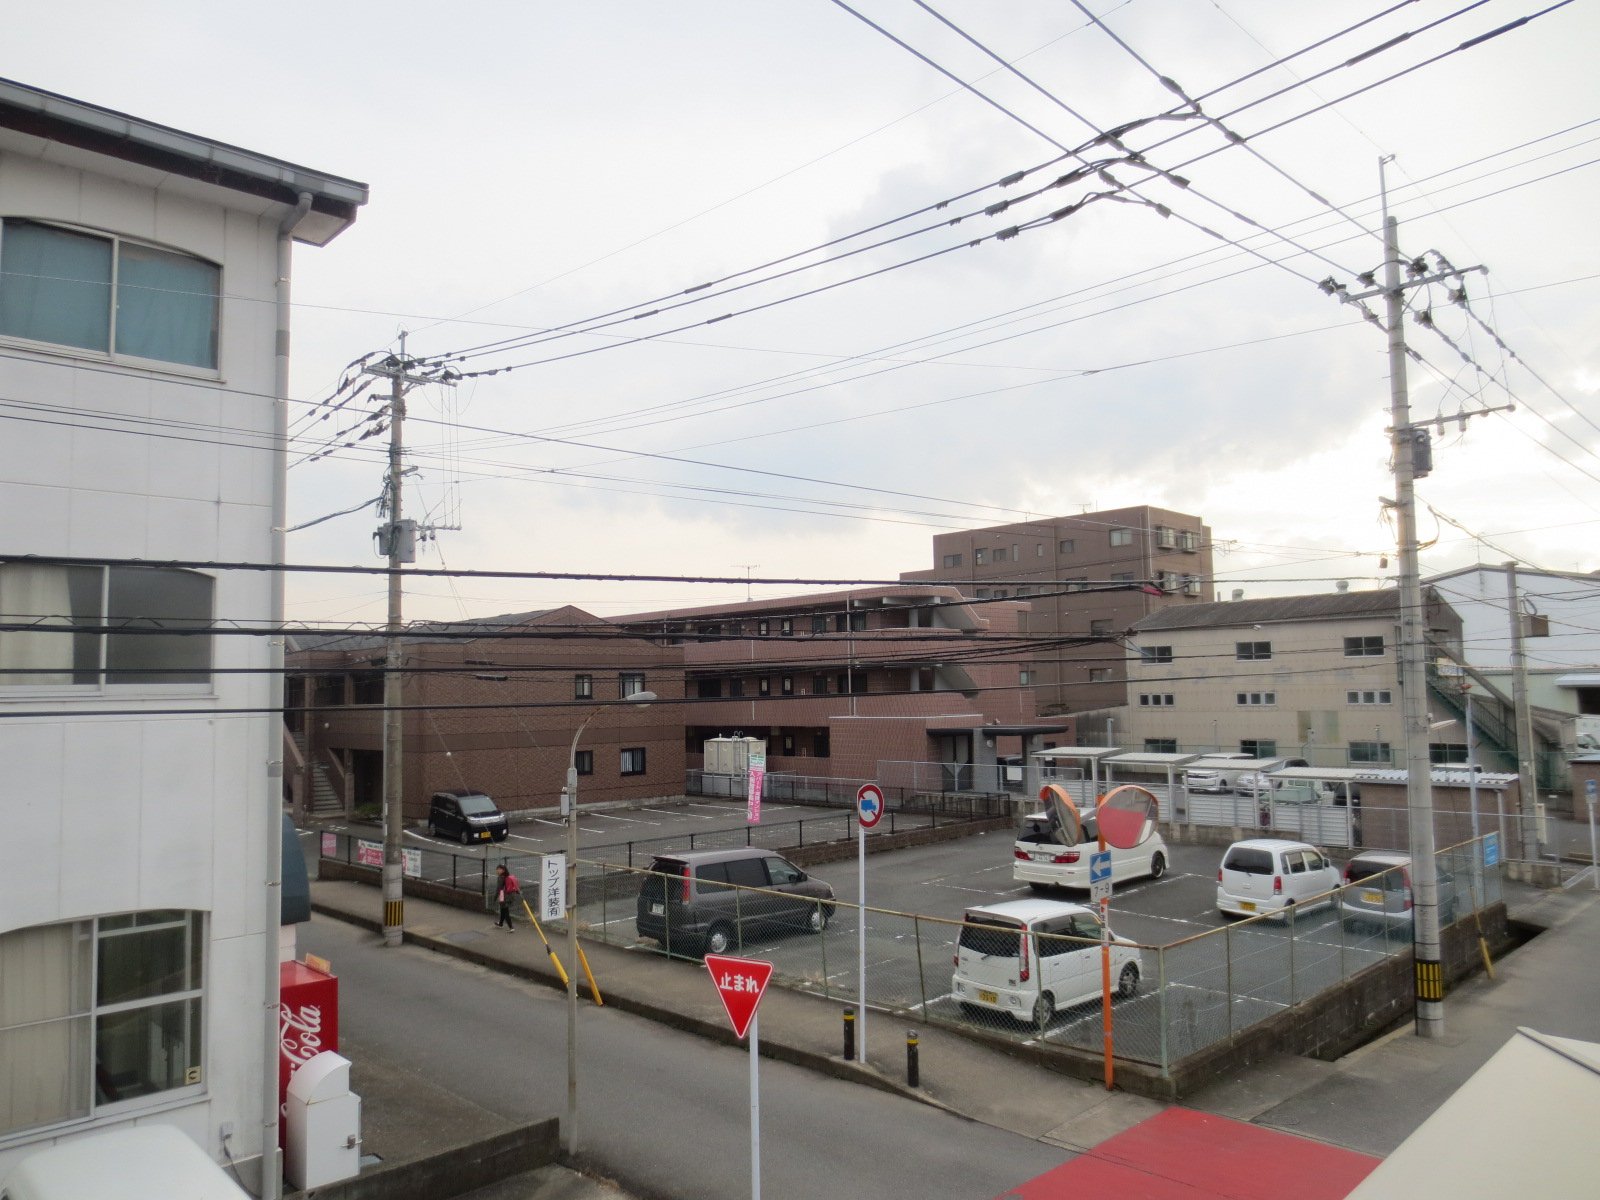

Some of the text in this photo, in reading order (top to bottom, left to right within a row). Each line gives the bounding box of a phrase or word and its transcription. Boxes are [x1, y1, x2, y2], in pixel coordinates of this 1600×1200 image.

[1094, 883, 1110, 897] 7-9
[719, 971, 760, 993] 止まれ
